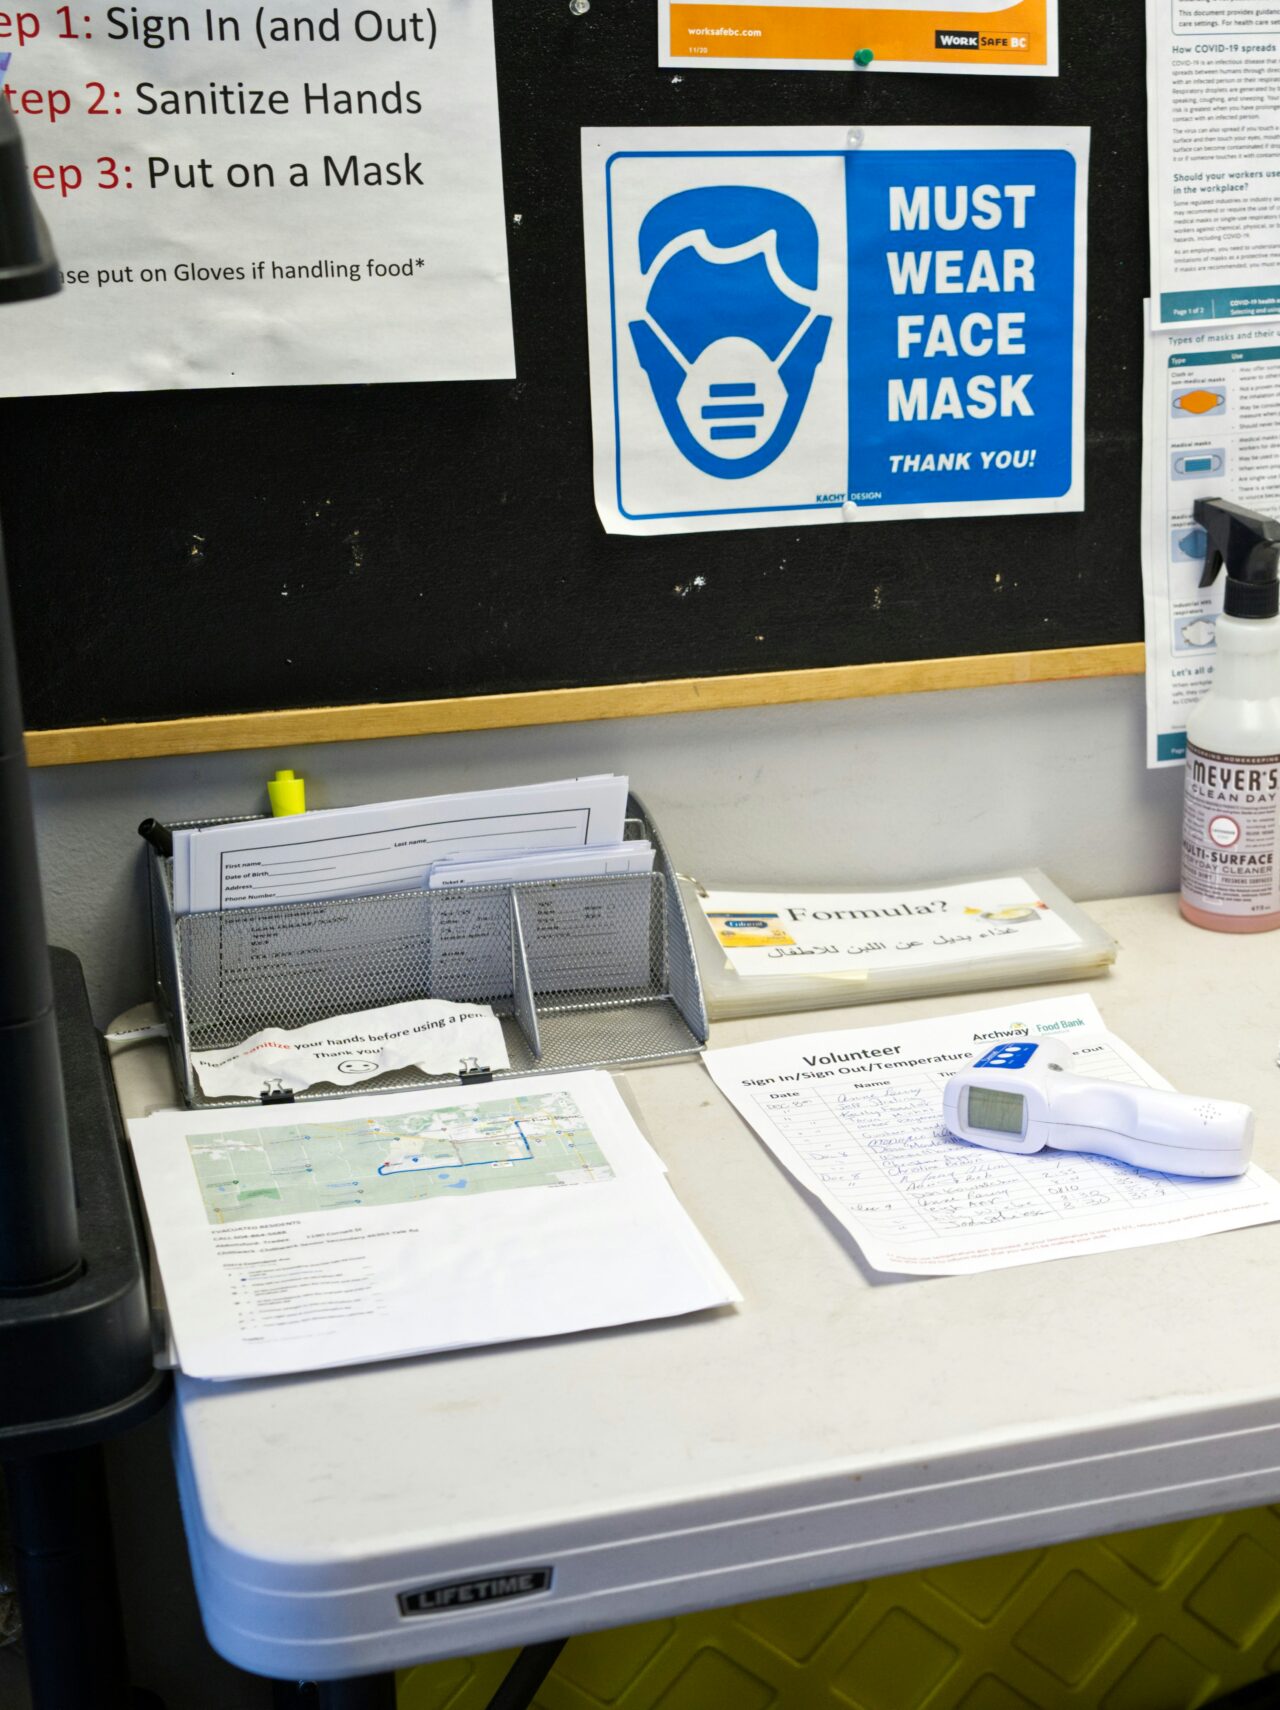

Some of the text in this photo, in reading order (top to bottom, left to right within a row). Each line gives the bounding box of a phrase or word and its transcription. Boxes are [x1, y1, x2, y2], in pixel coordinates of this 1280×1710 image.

[0, 5, 438, 50] ep 1: Sign In (and Out)
[688, 26, 762, 38] worksafebc.com
[1010, 37, 1027, 48] BC
[1172, 44, 1277, 54] How COVID-19 spreads
[3, 80, 423, 123] tep 2: Sanitize Hands
[33, 152, 425, 198] ep 3: Put on a Mask
[1173, 173, 1203, 182] Should
[1205, 172, 1225, 182] your
[1228, 170, 1263, 180] workers
[1266, 170, 1280, 178] use
[1173, 182, 1249, 194] in the workplace?
[888, 184, 1036, 232] MUST
[97, 264, 135, 288] put
[140, 266, 167, 283] on
[174, 262, 246, 283] Gloves
[251, 260, 266, 281] if
[271, 259, 361, 287] handling
[886, 249, 1036, 295] WEAR
[896, 312, 1026, 359] FACE
[1168, 336, 1193, 346] Types
[1195, 335, 1205, 343] of
[1207, 333, 1235, 342] masks
[1237, 331, 1253, 340] and
[1254, 329, 1275, 339] their
[888, 374, 1036, 423] MASK
[889, 449, 1037, 473] THANK YOU!
[1193, 761, 1279, 791] MEYER'S
[1191, 783, 1277, 804] CLEAN DAY
[1222, 865, 1273, 874] CLEANER
[225, 883, 253, 891] Address
[785, 900, 948, 922] Formula?
[243, 1040, 290, 1056] sanitize
[294, 1040, 322, 1051] your
[327, 1034, 365, 1047] hands
[368, 1027, 410, 1042] before
[413, 1017, 445, 1033] using
[449, 1014, 456, 1023] a
[972, 1018, 1085, 1043] Archway Food Bank
[313, 1049, 352, 1059] Thank
[803, 1043, 902, 1069] Volunteer
[741, 1050, 973, 1089] Sign In/Sign Out/Temperature
[769, 1045, 1104, 1099] Date Name Out
[418, 1574, 535, 1609] LIFETIME
